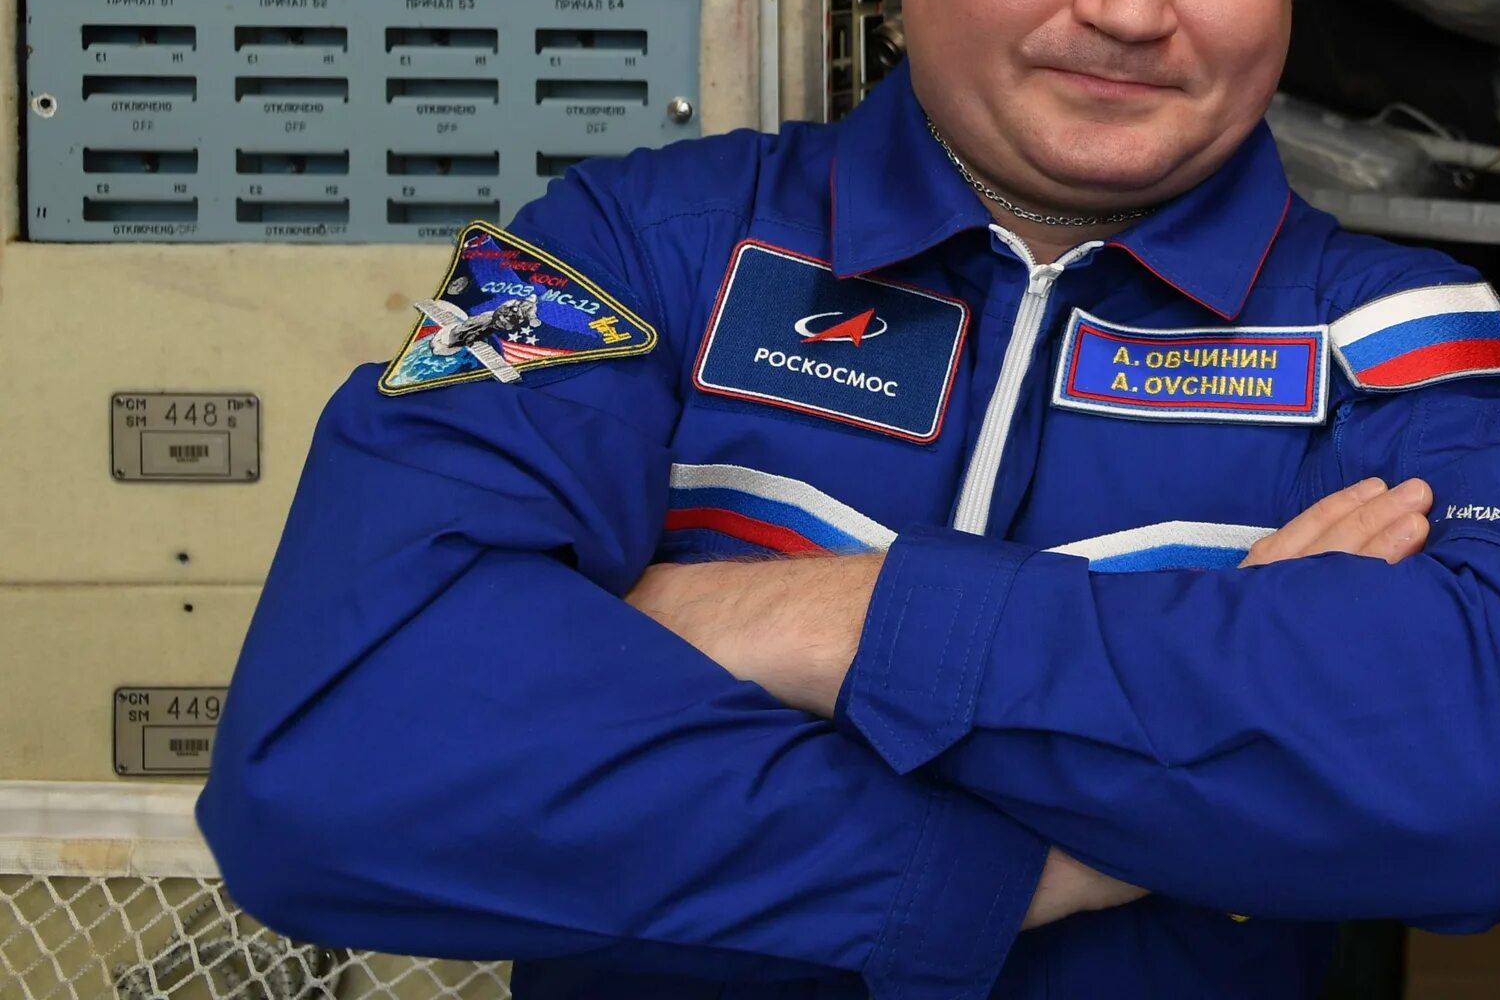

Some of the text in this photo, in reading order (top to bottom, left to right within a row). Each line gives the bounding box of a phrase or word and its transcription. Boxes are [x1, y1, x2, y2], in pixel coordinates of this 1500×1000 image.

[111, 101, 172, 112] ОТКЛЮЧЕНО
[264, 103, 323, 113] ОТКЛЮЧЕНО
[416, 104, 476, 115] ОТКЛЮЧЕНО
[566, 105, 626, 116] ОТКЛЮЧЕНО
[132, 120, 153, 131] OFF
[285, 121, 306, 132] OFF
[436, 122, 458, 133] OFF
[586, 122, 608, 134] OFF
[1112, 346, 1278, 369] А. ОВЧИНИН
[754, 347, 898, 397] РОСКОСМОС
[1110, 372, 1274, 397] A. OVCHININ
[126, 399, 147, 411] СМ
[164, 402, 218, 427] 448
[126, 416, 147, 428] SM
[129, 693, 220, 720] СМ 449
[129, 710, 149, 722] SM
